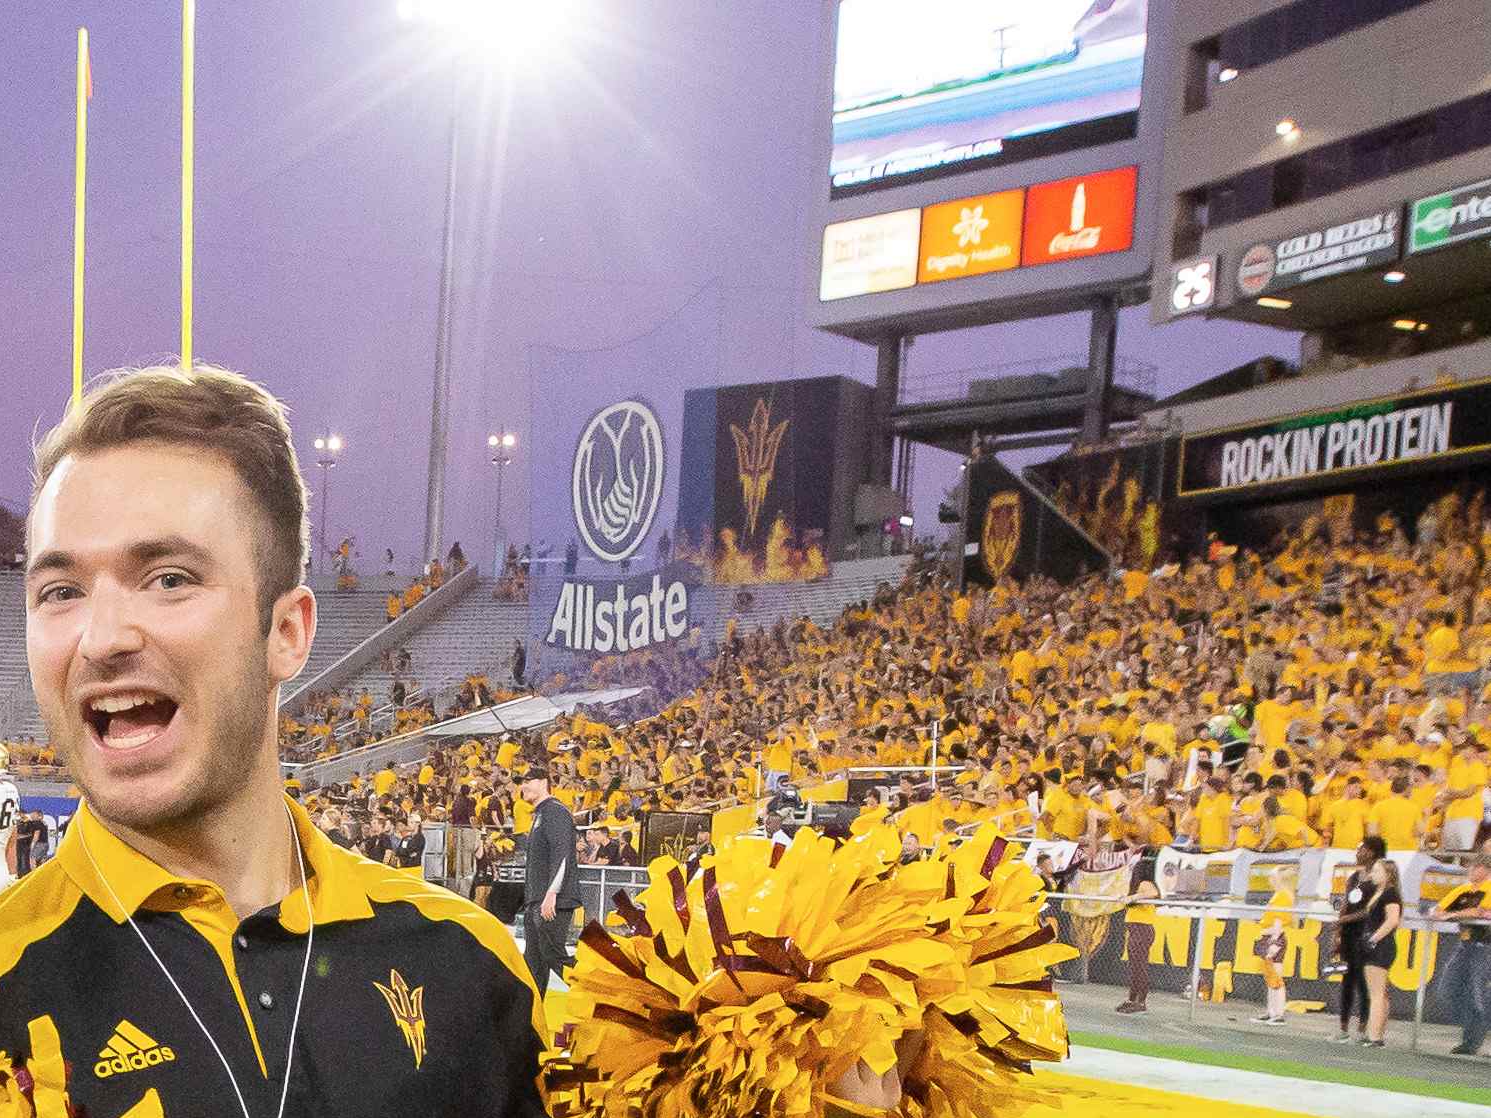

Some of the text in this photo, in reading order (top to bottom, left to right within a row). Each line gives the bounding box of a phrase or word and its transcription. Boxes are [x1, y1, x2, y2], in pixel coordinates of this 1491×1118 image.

[1049, 226, 1101, 256] Coca-Cola
[1276, 230, 1323, 259] COLD
[1324, 212, 1383, 248] BEERS
[1323, 400, 1453, 471] PROTEIN
[546, 574, 688, 653] Allstate
[93, 1045, 176, 1080] adidas
